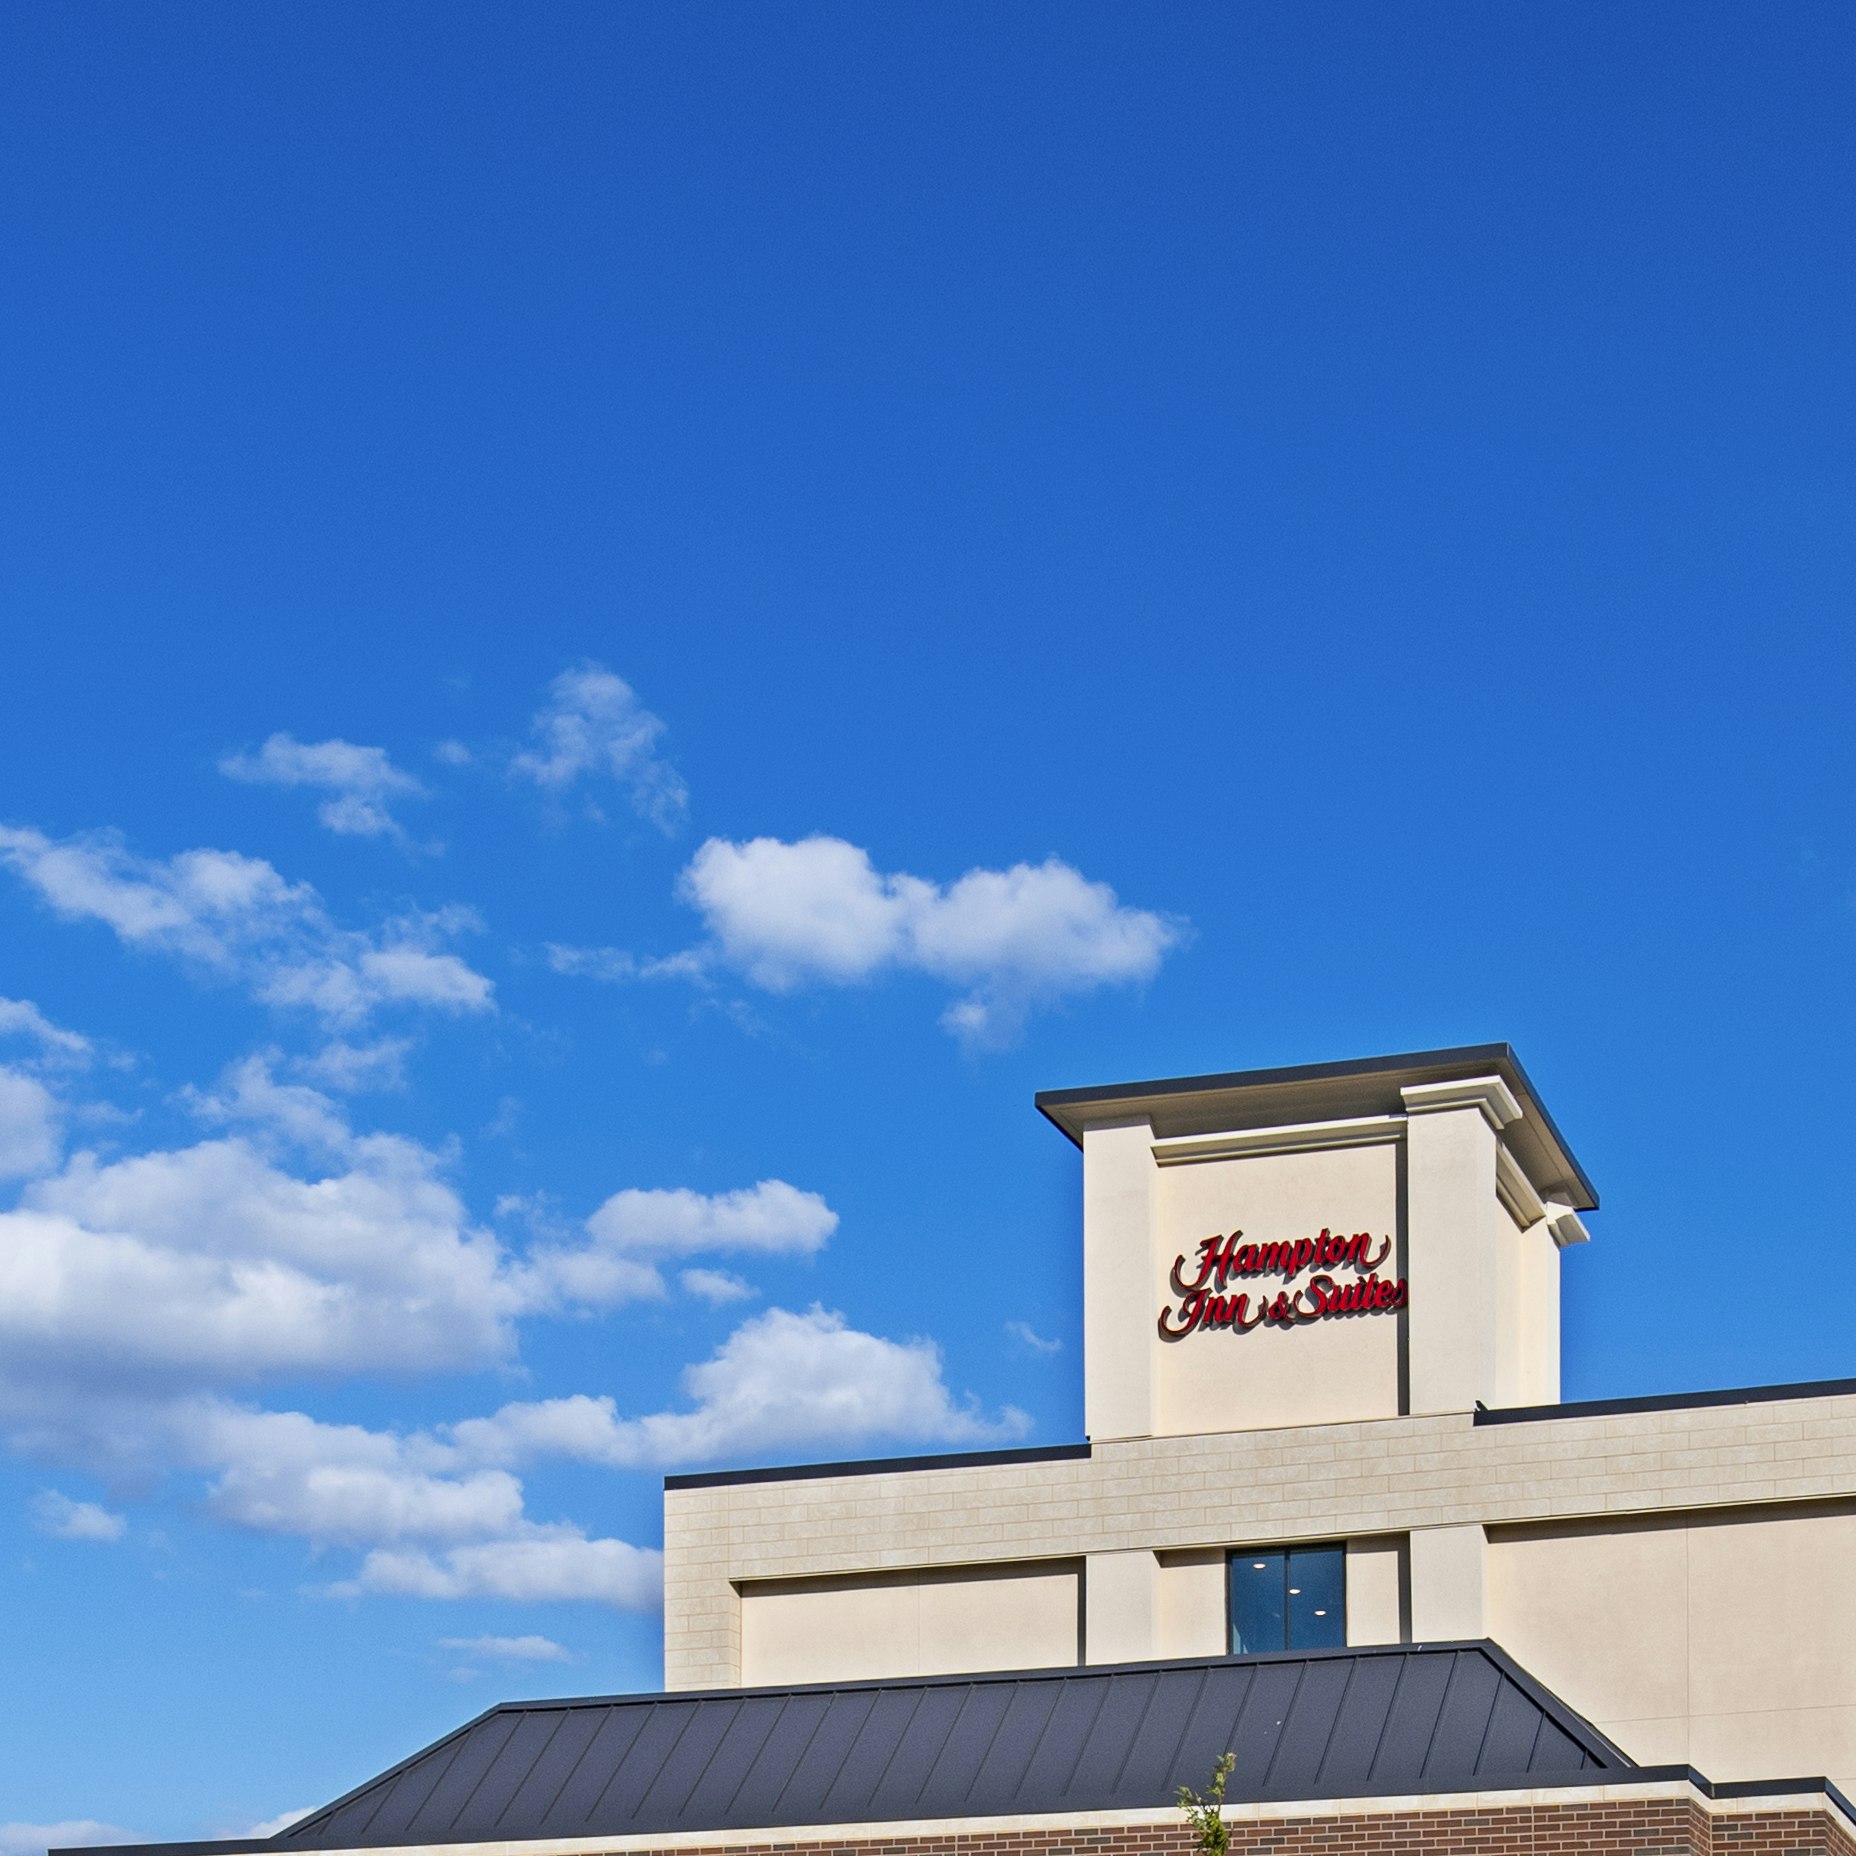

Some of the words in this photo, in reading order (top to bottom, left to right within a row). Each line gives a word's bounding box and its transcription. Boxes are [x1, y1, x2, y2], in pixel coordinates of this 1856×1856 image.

[1174, 1228, 1391, 1289] Hampton
[1160, 1288, 1266, 1335] Inn
[1268, 1291, 1296, 1322] &
[1293, 1272, 1408, 1318] Suites
